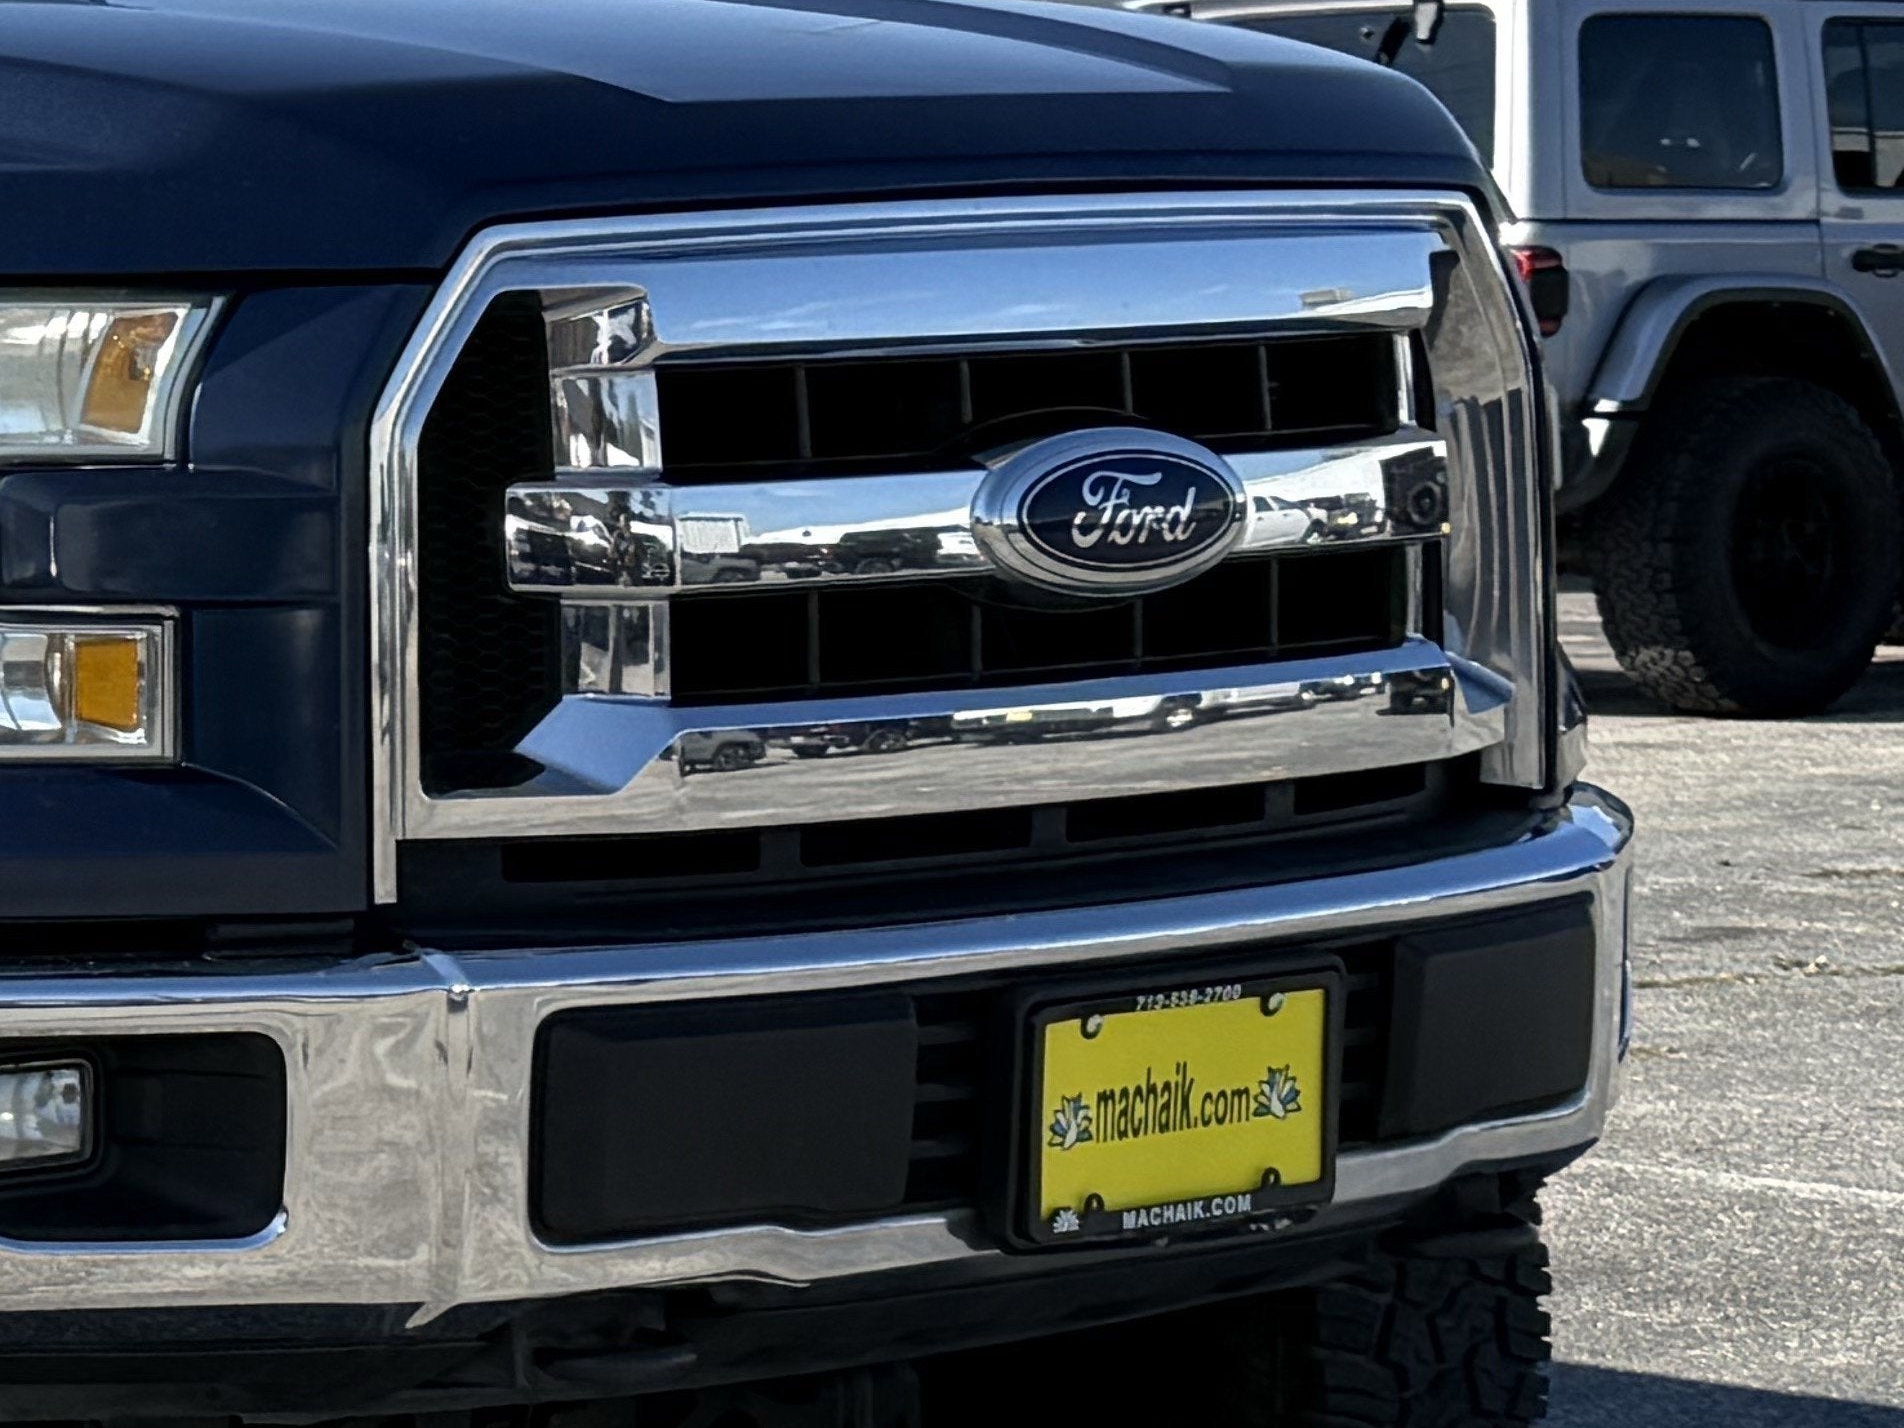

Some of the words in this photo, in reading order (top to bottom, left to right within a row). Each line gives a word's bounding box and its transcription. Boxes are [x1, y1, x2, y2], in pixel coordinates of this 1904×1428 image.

[1071, 471, 1196, 548] Ford
[1095, 1061, 1251, 1142] machaik.com
[1122, 1194, 1252, 1229] MACHAIK.COM
